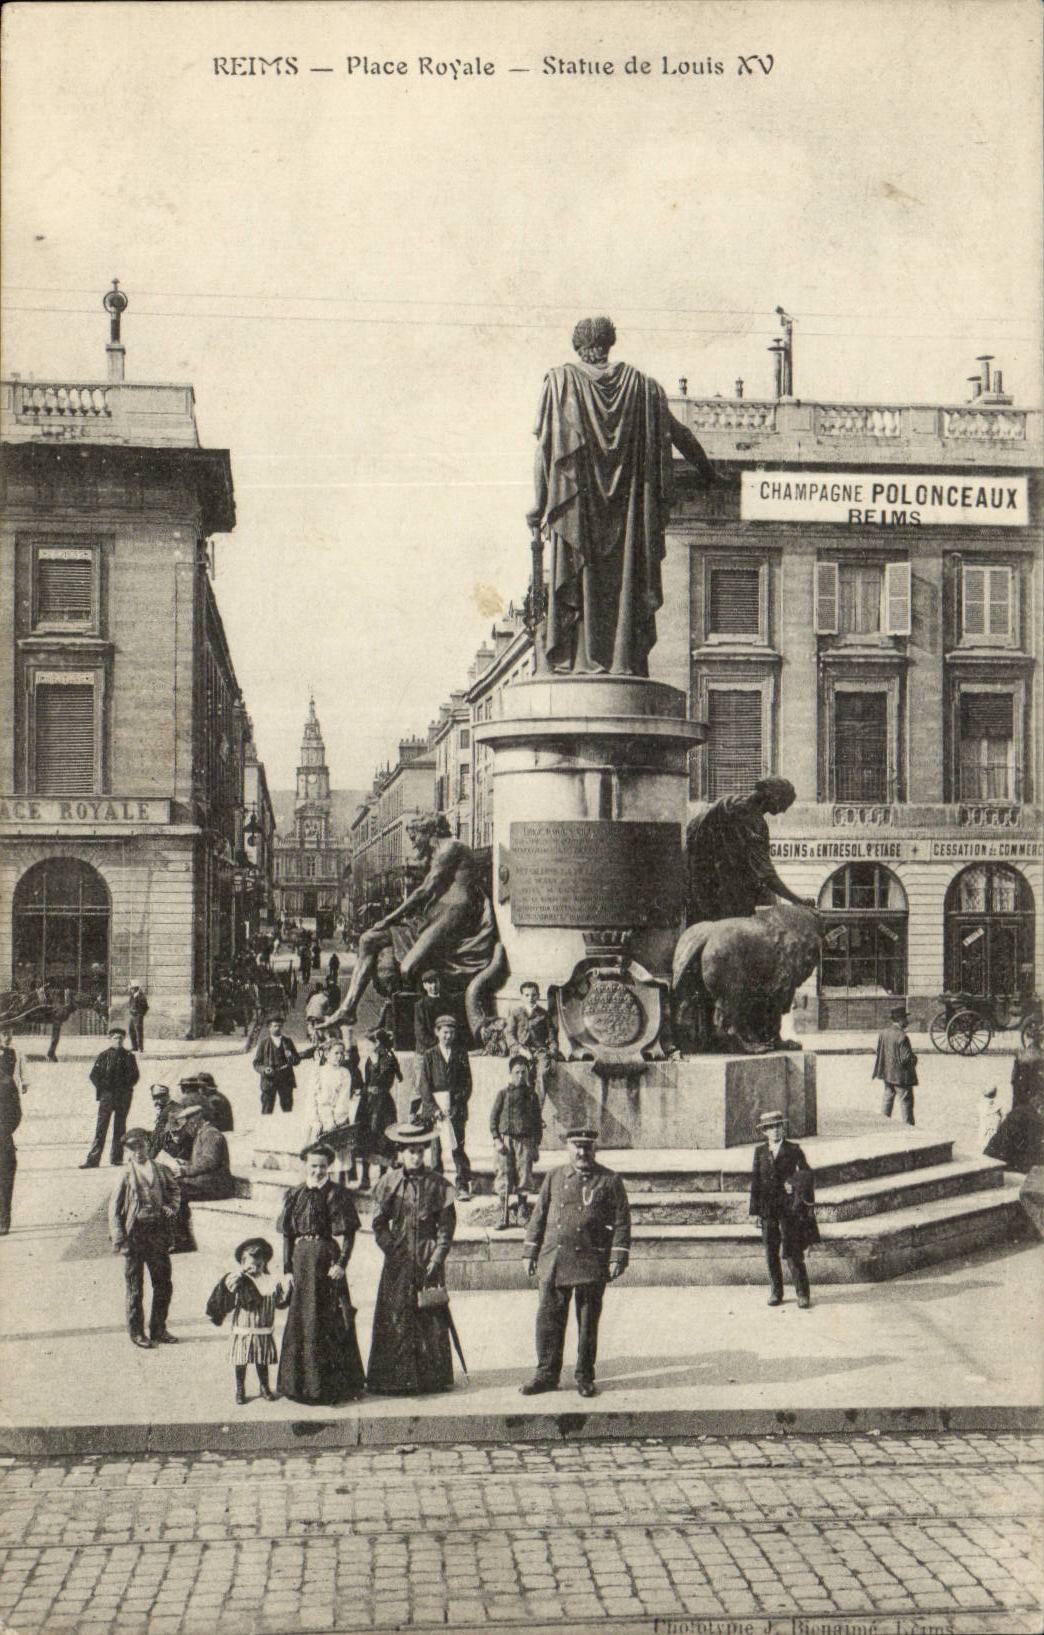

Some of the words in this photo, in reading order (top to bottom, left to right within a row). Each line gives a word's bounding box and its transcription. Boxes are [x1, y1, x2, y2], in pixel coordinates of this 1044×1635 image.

[760, 481, 863, 503] CHAMPAGNE
[872, 483, 1018, 510] POLONCEAUX
[848, 508, 922, 527] REIMS
[60, 801, 150, 821] ROYALE
[933, 844, 987, 856] CESSATION
